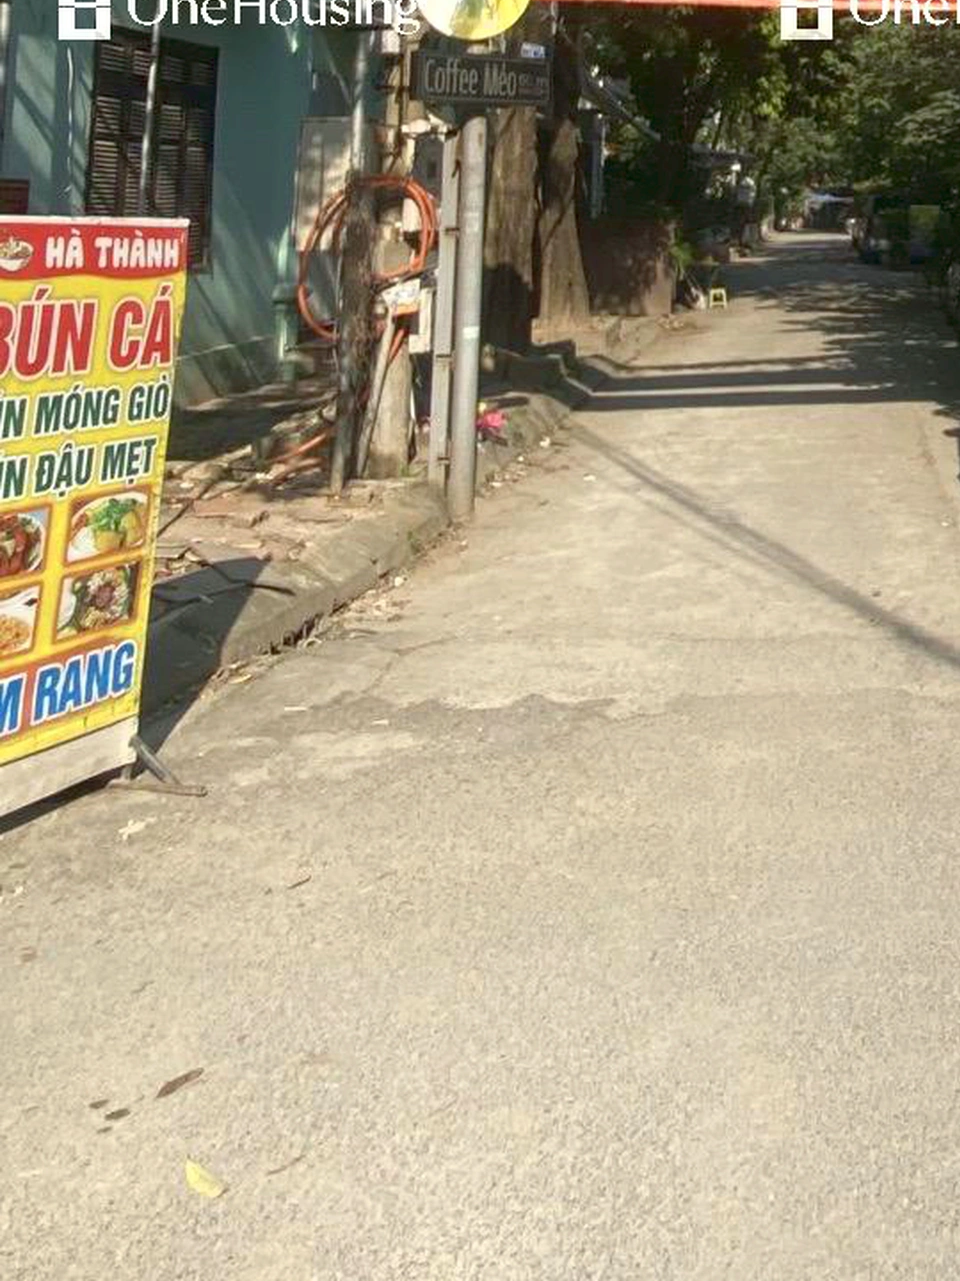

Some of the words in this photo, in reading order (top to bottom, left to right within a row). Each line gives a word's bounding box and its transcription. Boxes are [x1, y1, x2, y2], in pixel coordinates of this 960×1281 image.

[424, 58, 479, 95] Coffee
[45, 228, 84, 268] HÀ
[94, 229, 180, 268] THÀNH
[109, 284, 173, 370] CÁ
[34, 384, 120, 435] MÓNG
[128, 374, 170, 422] GIÒ
[34, 442, 94, 497] ĐẬU
[100, 437, 157, 485] MẸT
[32, 640, 136, 723] RANG
